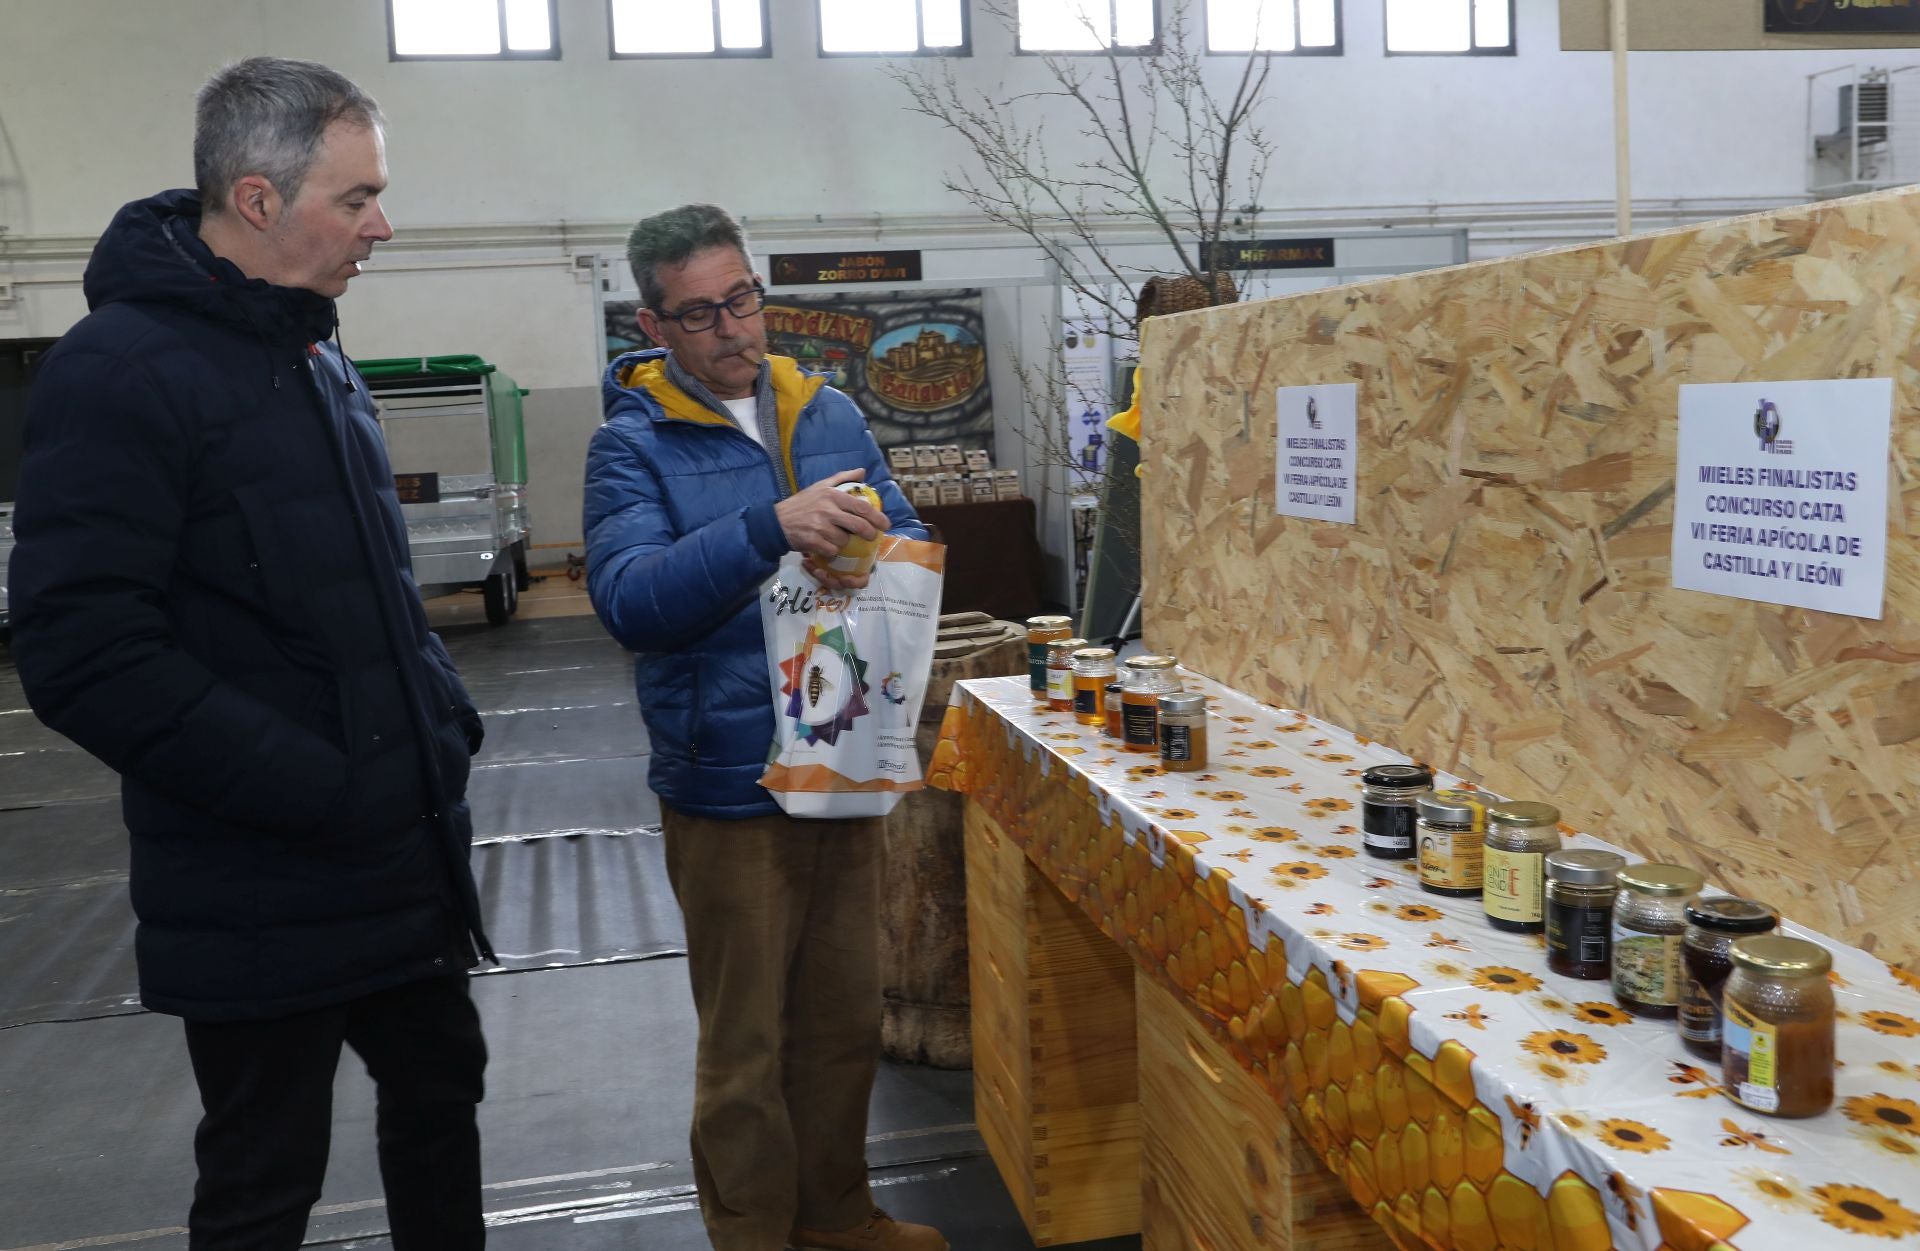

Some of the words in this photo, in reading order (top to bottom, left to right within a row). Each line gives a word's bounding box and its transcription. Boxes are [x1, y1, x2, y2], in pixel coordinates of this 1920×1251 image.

[837, 253, 886, 268] JABÓN
[818, 269, 866, 281] ZORRO
[1699, 465, 1754, 486] MIELES
[1758, 468, 1857, 491] FINALISTAS
[1705, 494, 1796, 519] CONCURSO
[1799, 502, 1845, 523] CATA
[1691, 522, 1704, 540] VI
[1708, 524, 1754, 546] FERIA
[1756, 526, 1831, 554] APÍCOLA
[1835, 535, 1862, 557] DE
[1702, 551, 1778, 578] CASTILLA
[1781, 561, 1792, 580] Y
[1795, 561, 1844, 587] LEÓN
